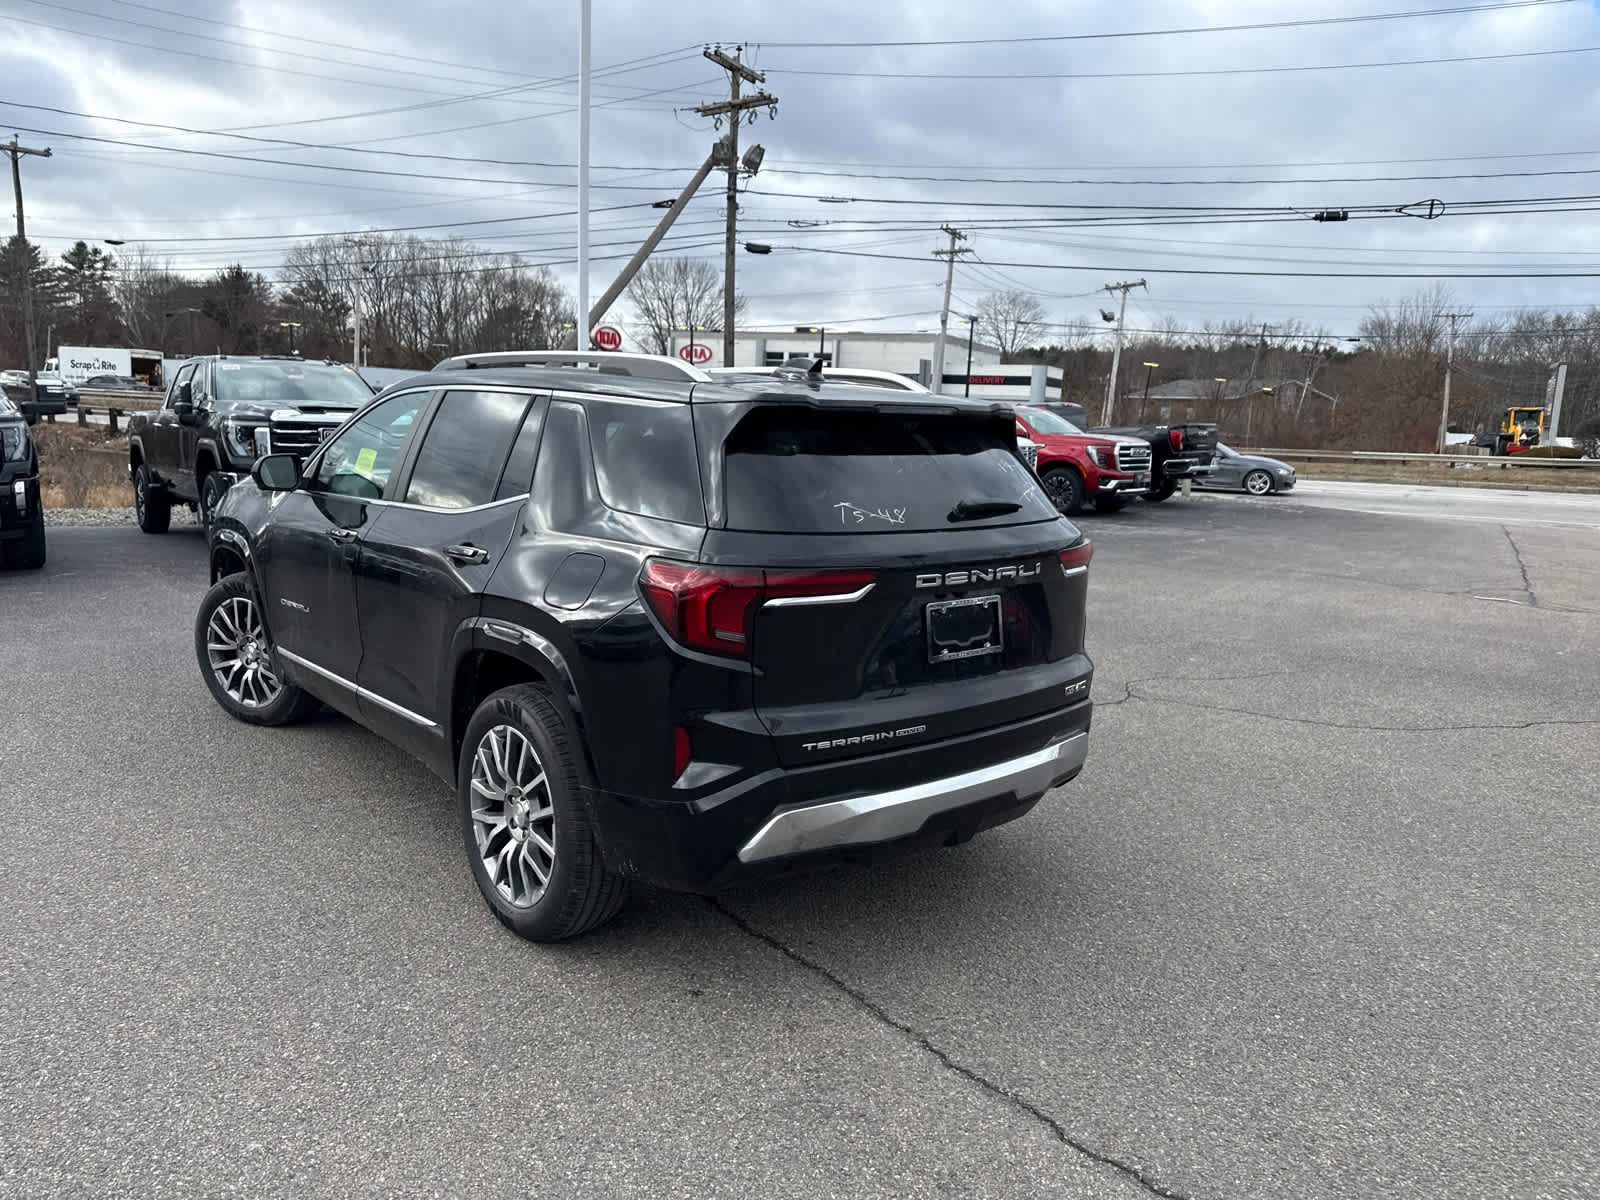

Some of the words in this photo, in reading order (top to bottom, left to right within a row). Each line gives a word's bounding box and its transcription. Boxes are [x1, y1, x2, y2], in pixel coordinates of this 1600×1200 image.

[70, 359, 92, 371] Scrap
[101, 360, 117, 371] Rite
[968, 375, 1005, 385] DELIVERY
[915, 561, 1041, 588] DENALI
[802, 731, 895, 751] TERRAIN
